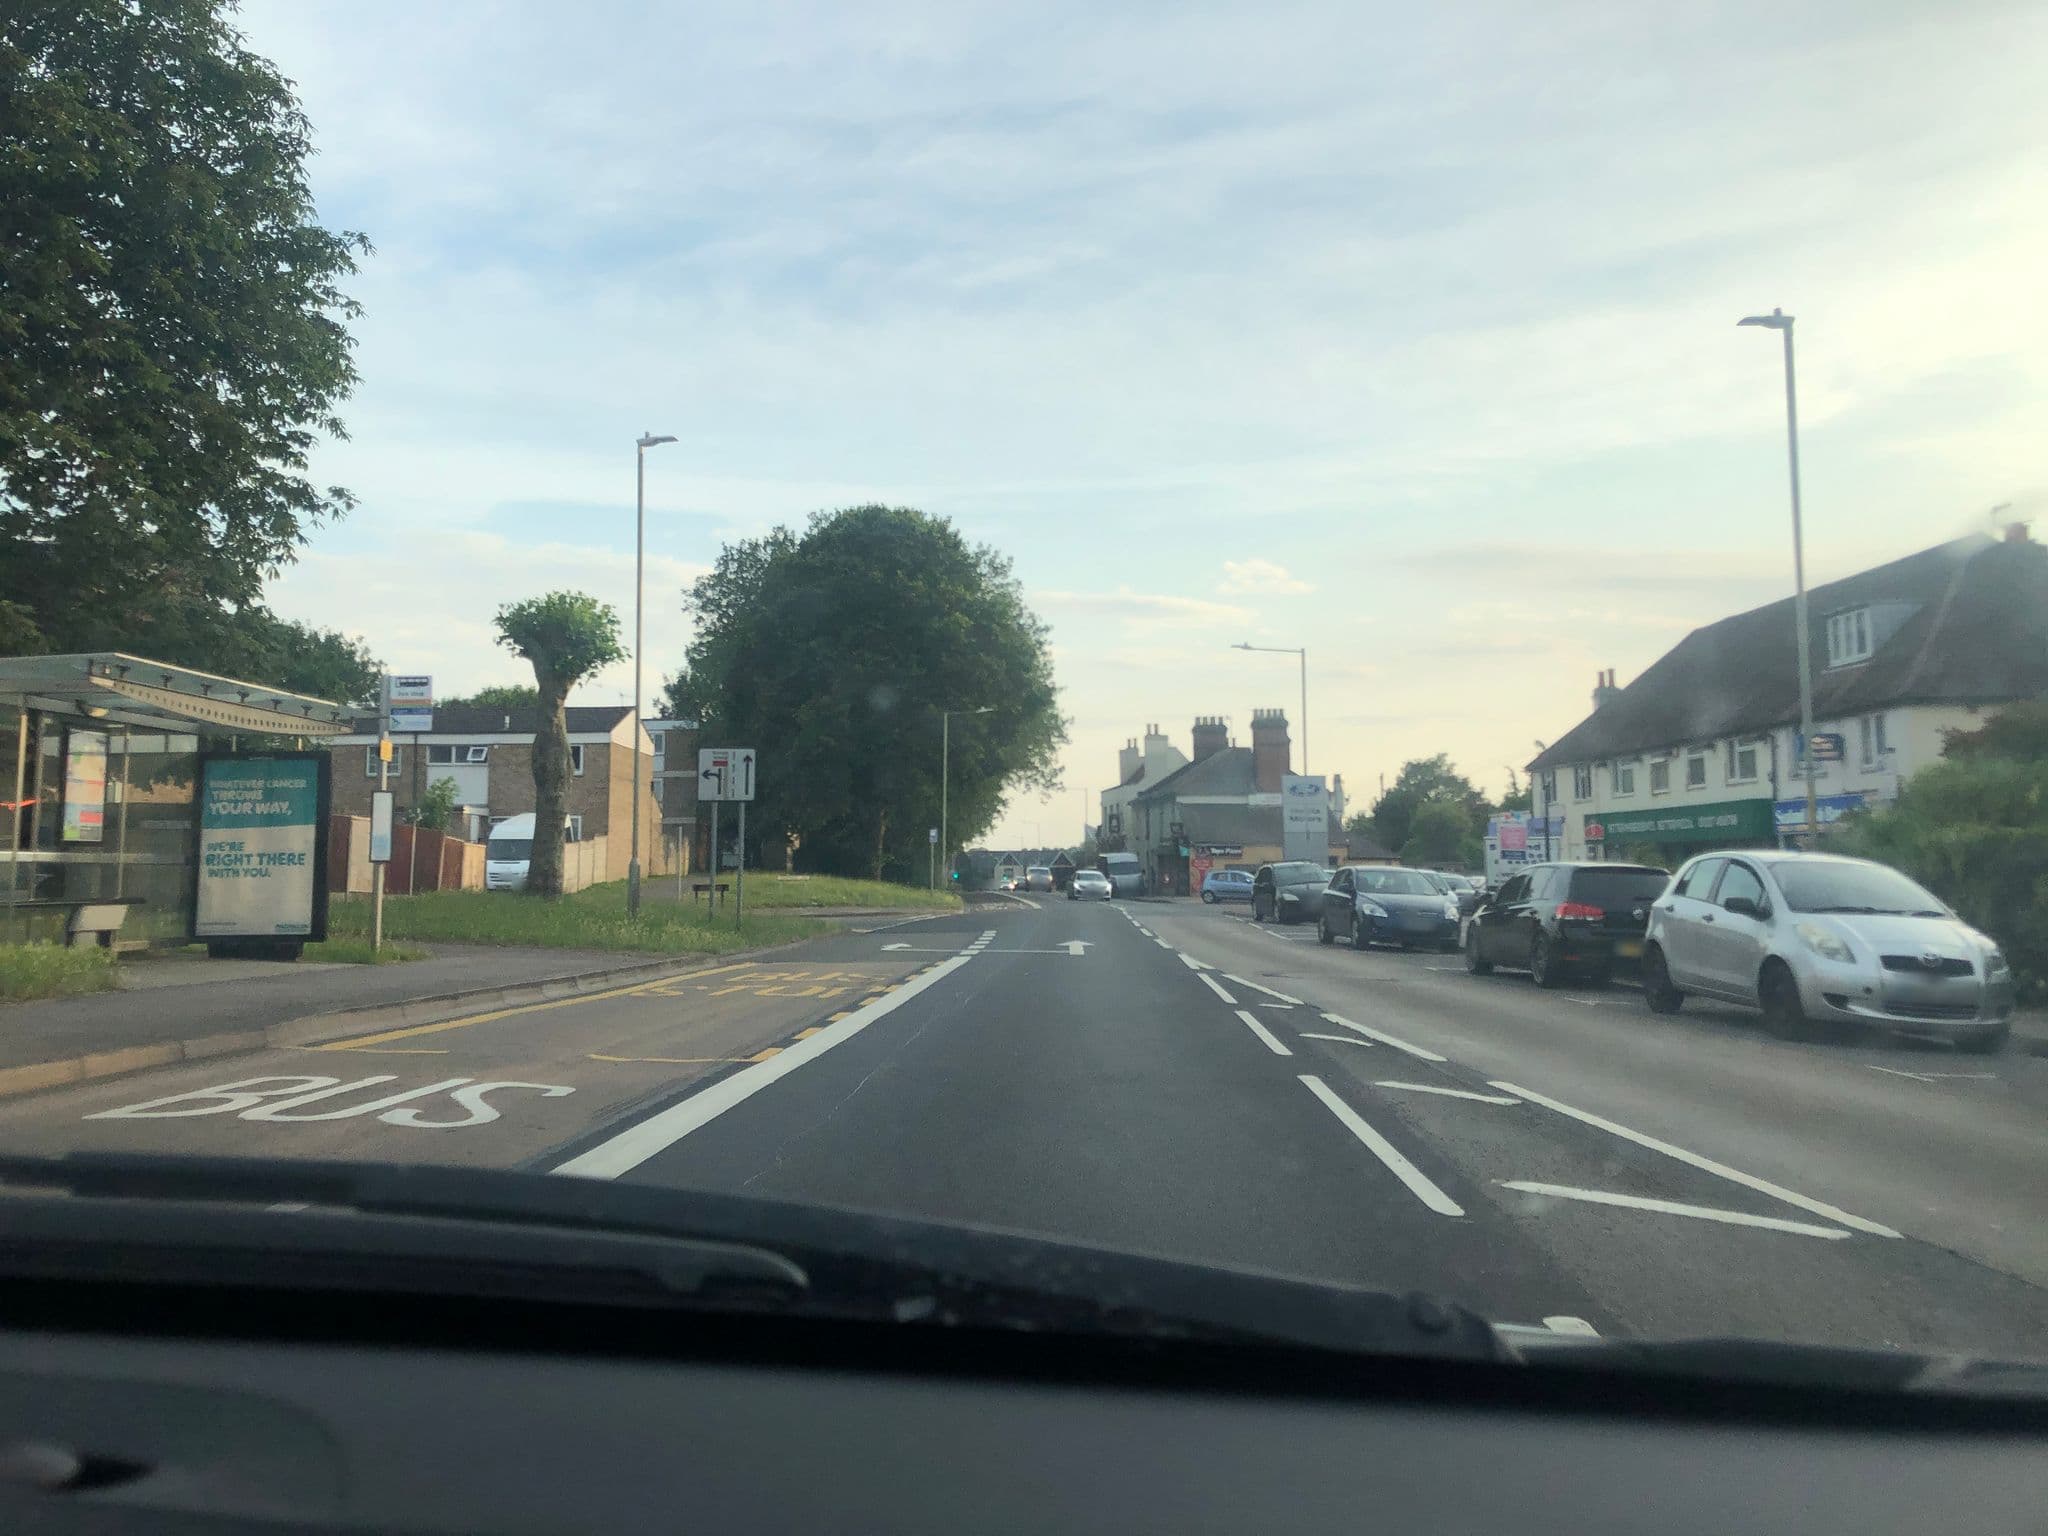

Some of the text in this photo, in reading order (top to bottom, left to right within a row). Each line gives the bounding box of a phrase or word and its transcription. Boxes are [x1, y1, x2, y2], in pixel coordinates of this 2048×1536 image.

[209, 802, 253, 815] YOUR
[205, 852, 306, 867] RIGHT THERE
[207, 867, 240, 879] WITH
[81, 1075, 577, 1129] BUS
